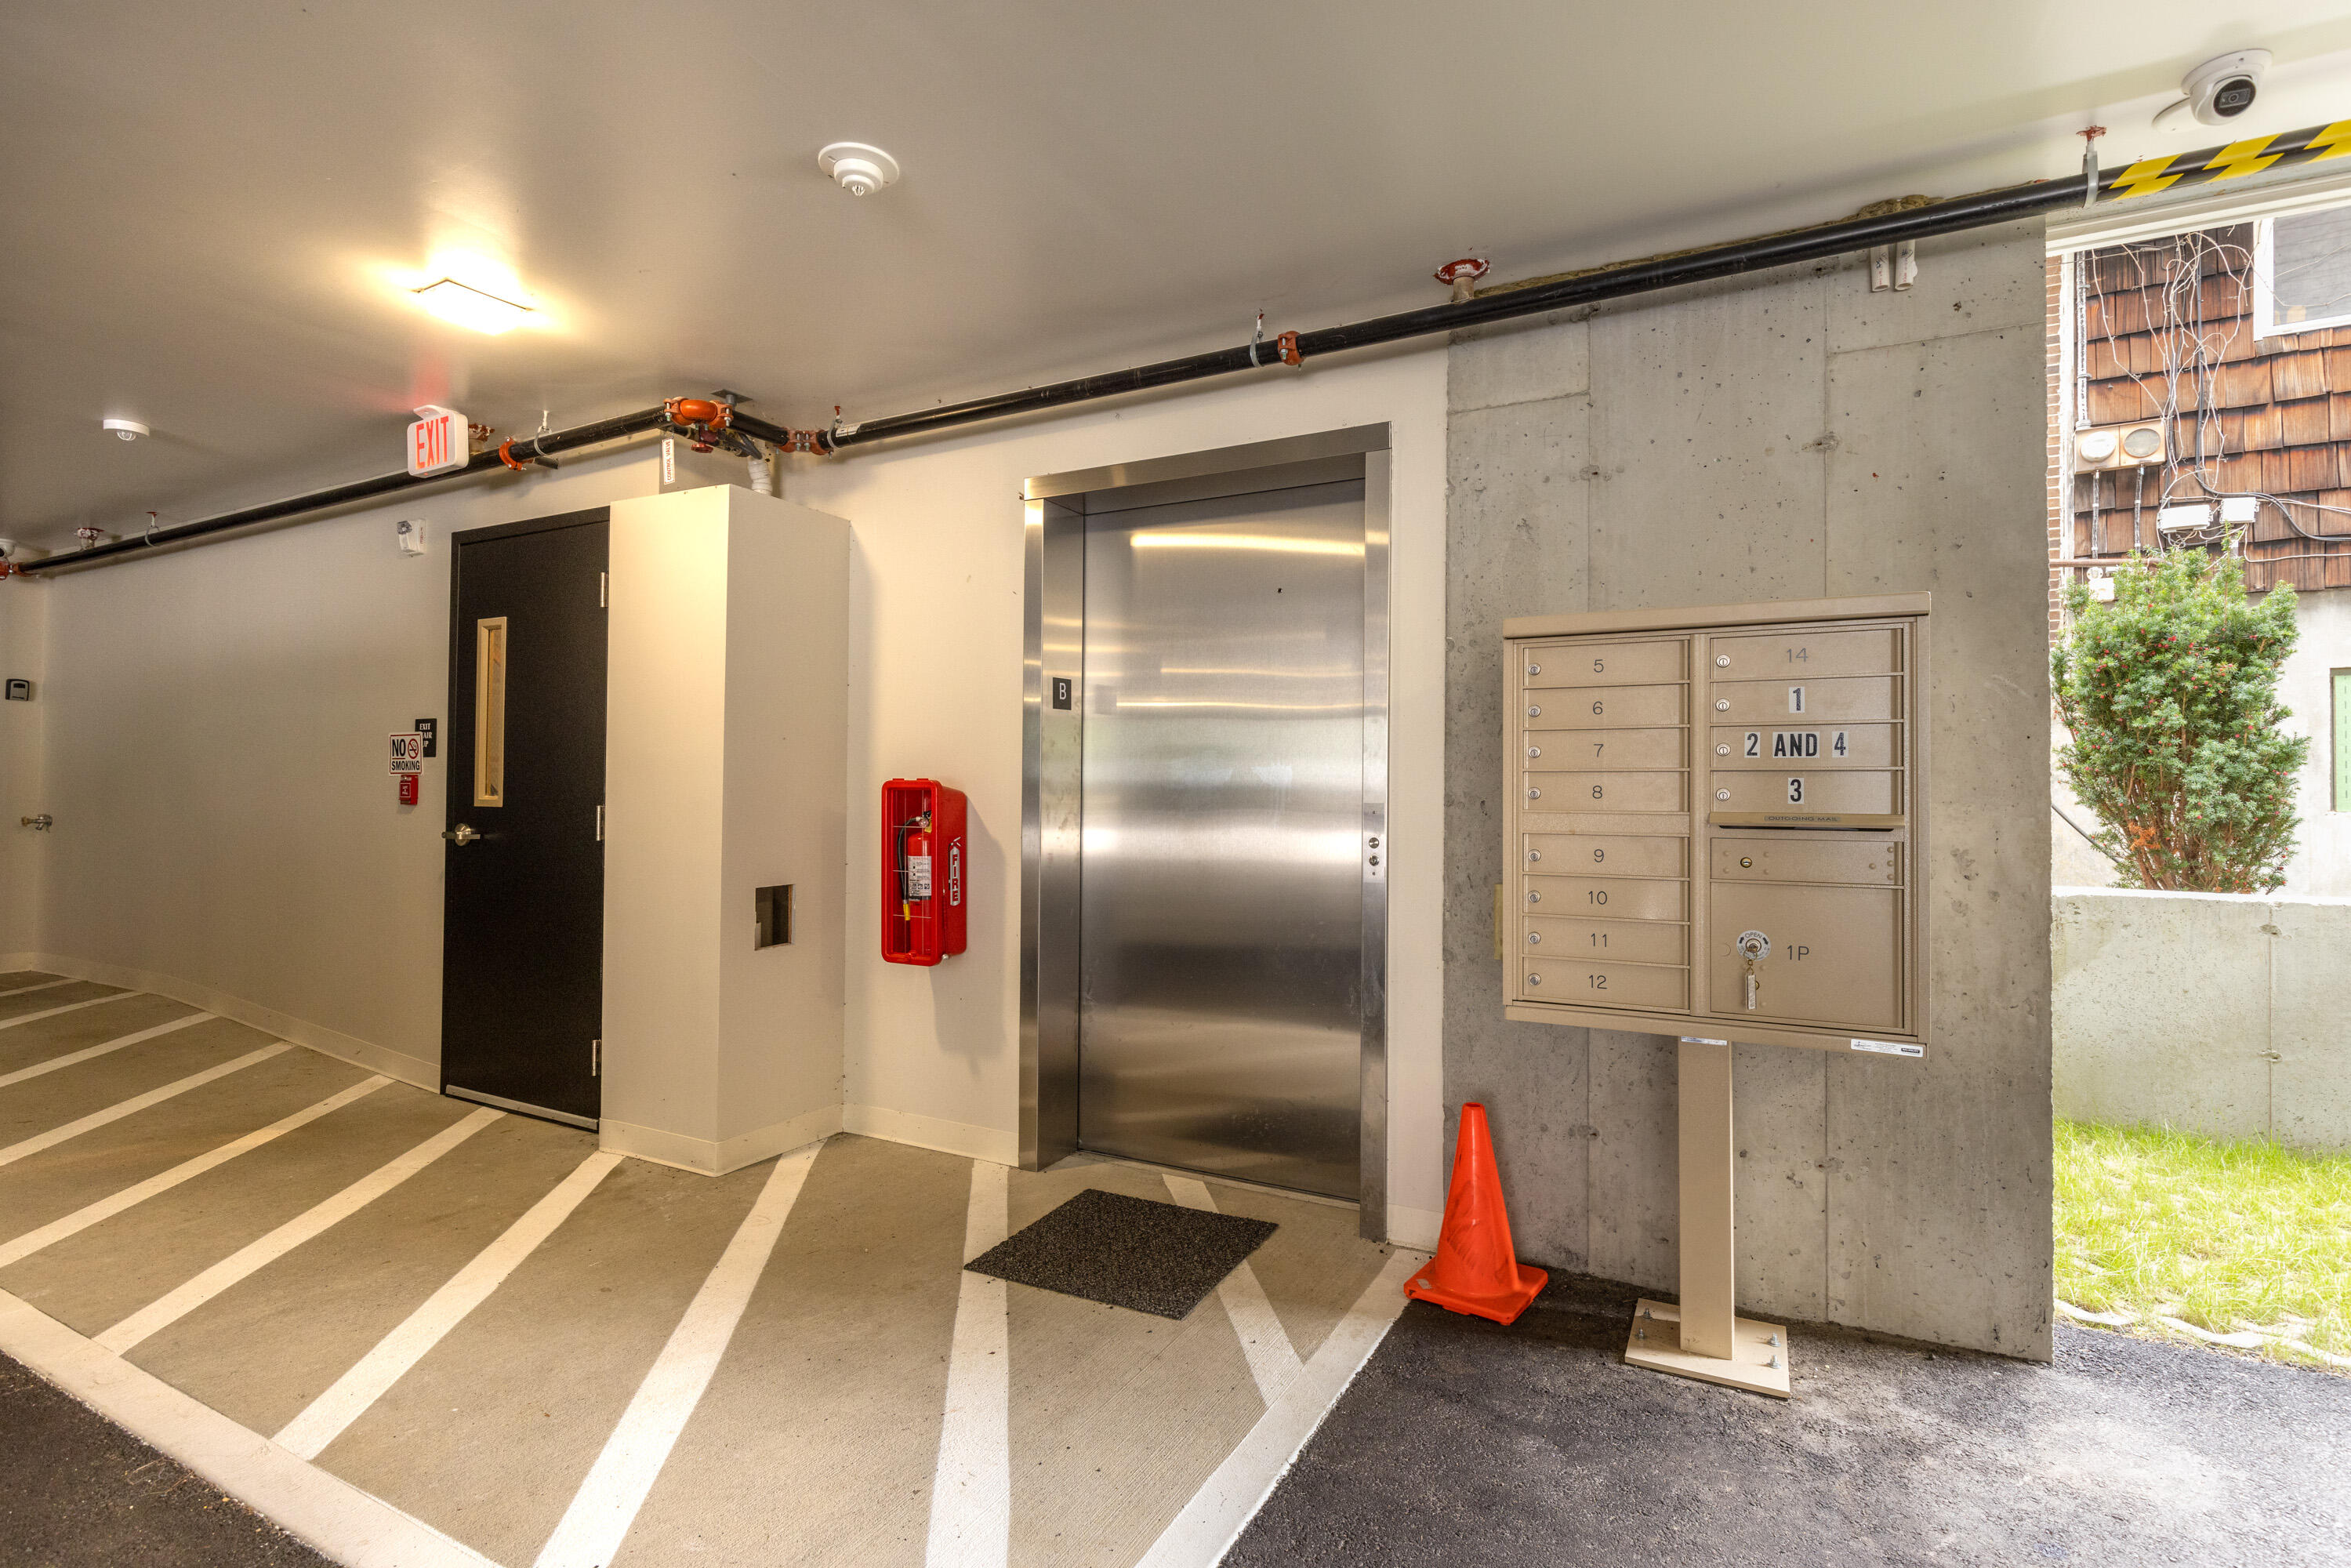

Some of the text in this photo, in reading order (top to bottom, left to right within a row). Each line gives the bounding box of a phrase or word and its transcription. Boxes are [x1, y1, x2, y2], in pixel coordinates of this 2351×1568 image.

[415, 416, 449, 470] EXIT
[1787, 648, 1809, 663] 14
[1593, 659, 1605, 673] 5
[1059, 682, 1067, 700] B
[1793, 688, 1801, 711] 1
[1592, 701, 1603, 716] 6
[392, 739, 406, 757] NO
[1593, 743, 1604, 758] 7
[1747, 732, 1846, 757] 2 AND 4
[391, 760, 420, 771] SMOKING
[1591, 785, 1603, 800] 8
[1790, 779, 1802, 802] 3
[1594, 848, 1605, 863] 9
[1588, 890, 1608, 906] 10
[1591, 932, 1607, 948] 11
[1787, 945, 1809, 961] 1P
[1588, 975, 1608, 990] 12
